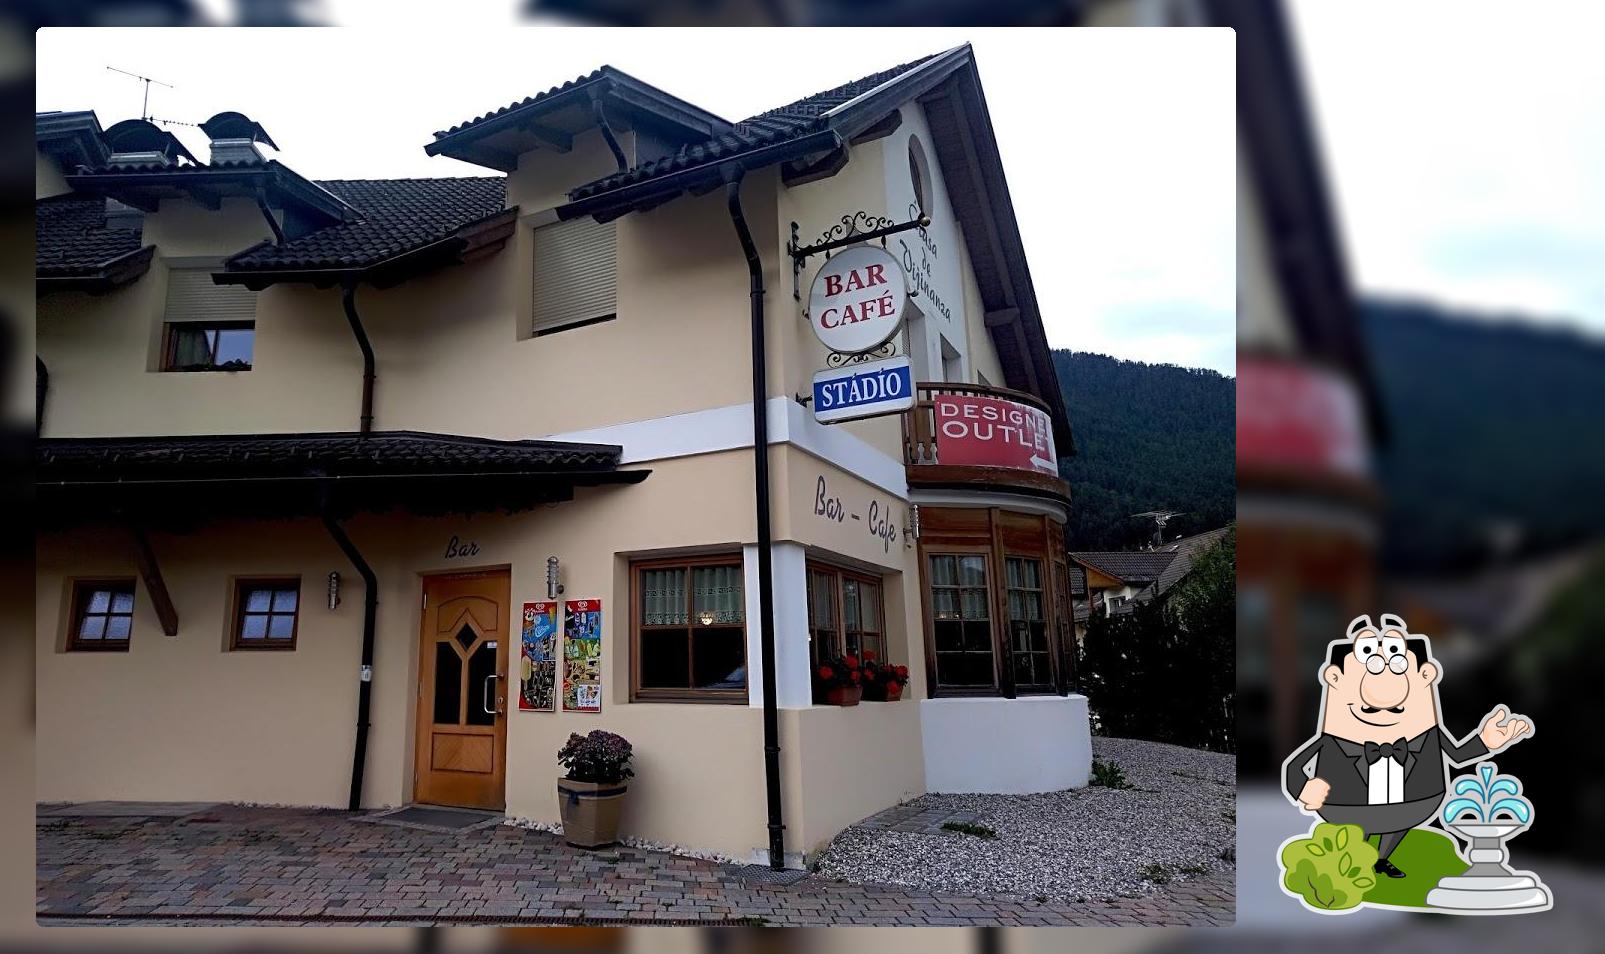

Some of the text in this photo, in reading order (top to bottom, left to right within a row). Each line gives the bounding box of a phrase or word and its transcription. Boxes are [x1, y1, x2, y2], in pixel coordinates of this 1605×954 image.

[921, 246, 932, 279] de
[824, 263, 888, 297] BAR
[820, 290, 896, 329] CAFÉ
[940, 403, 1046, 436] DESIGNE
[942, 420, 1047, 451] OUTLE
[814, 475, 845, 523] Bar
[868, 499, 896, 554] Cafe
[444, 535, 481, 559] Bar
